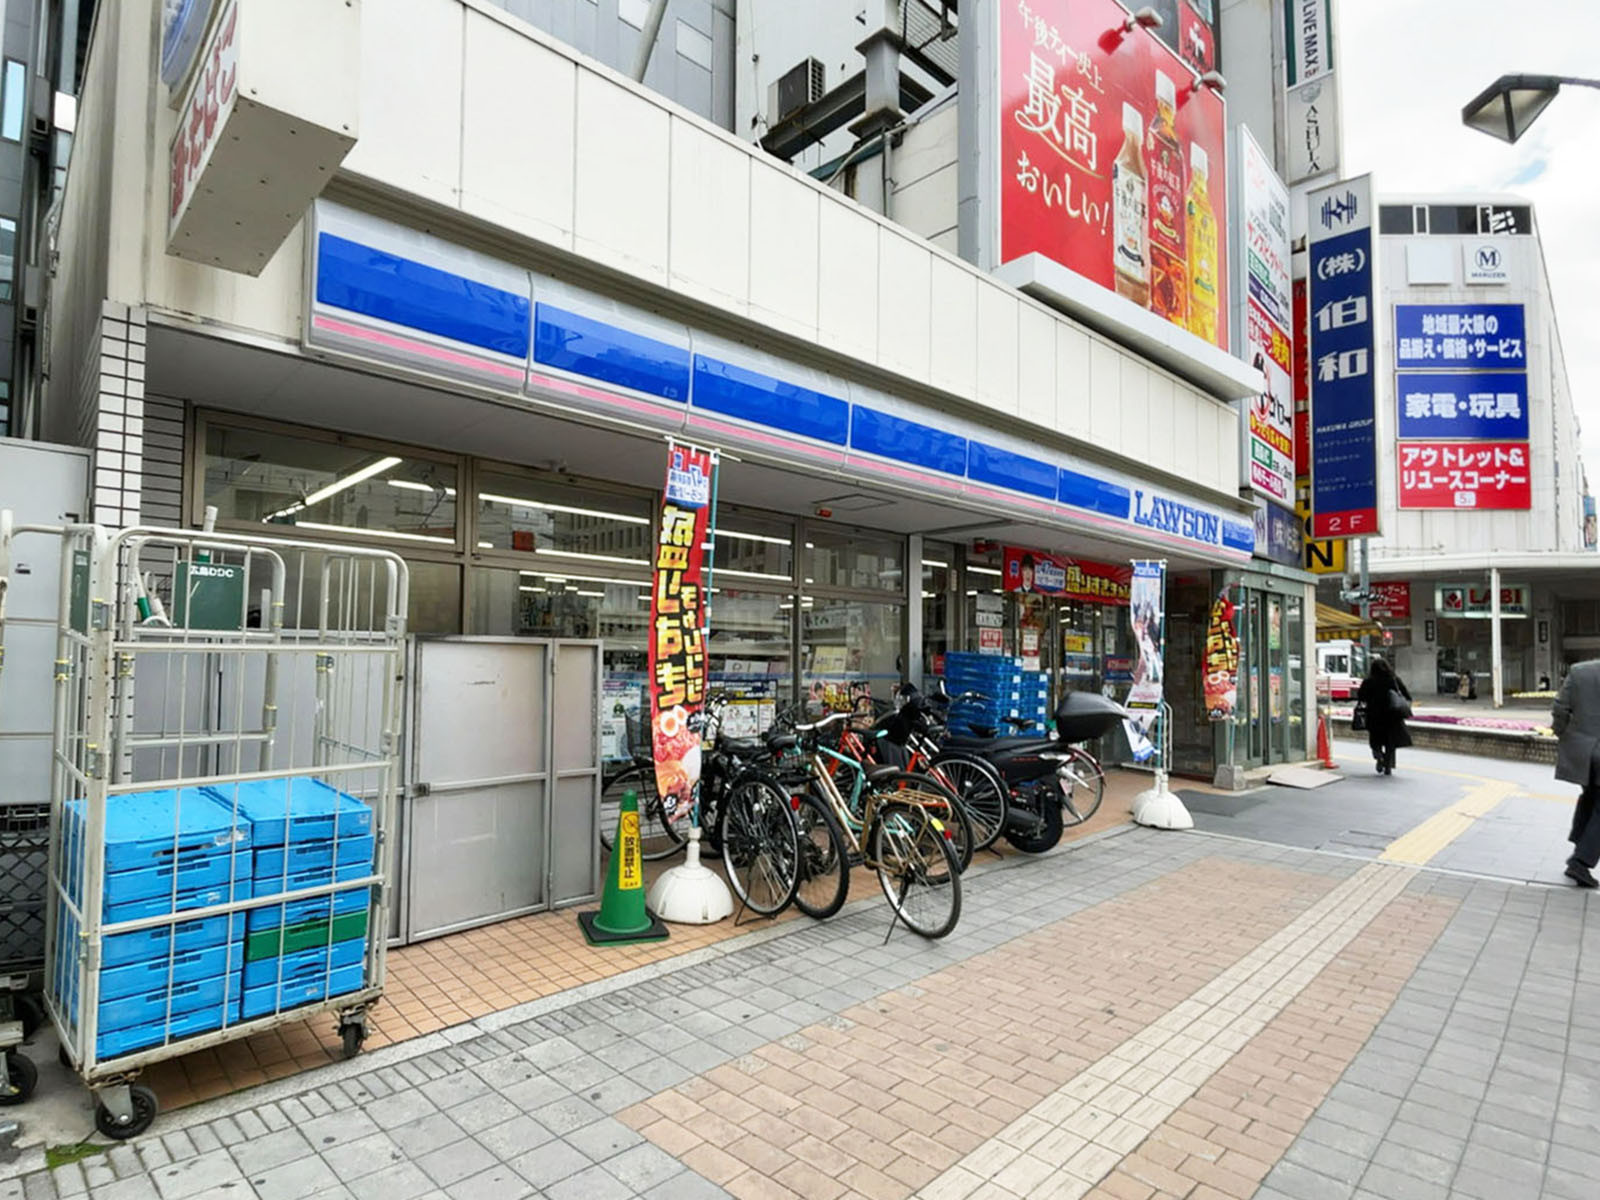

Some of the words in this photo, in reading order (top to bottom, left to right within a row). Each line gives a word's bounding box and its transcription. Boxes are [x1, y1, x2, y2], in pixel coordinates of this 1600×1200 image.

[1015, 51, 1100, 172] 最高
[1016, 150, 1110, 236] おいしい!
[1422, 314, 1498, 335] 地域最大級の
[1405, 393, 1521, 419] 家電・玩具
[1402, 447, 1524, 468] アウトレット&
[1403, 470, 1526, 490] リユースコーナー
[1134, 490, 1219, 545] LAWSON
